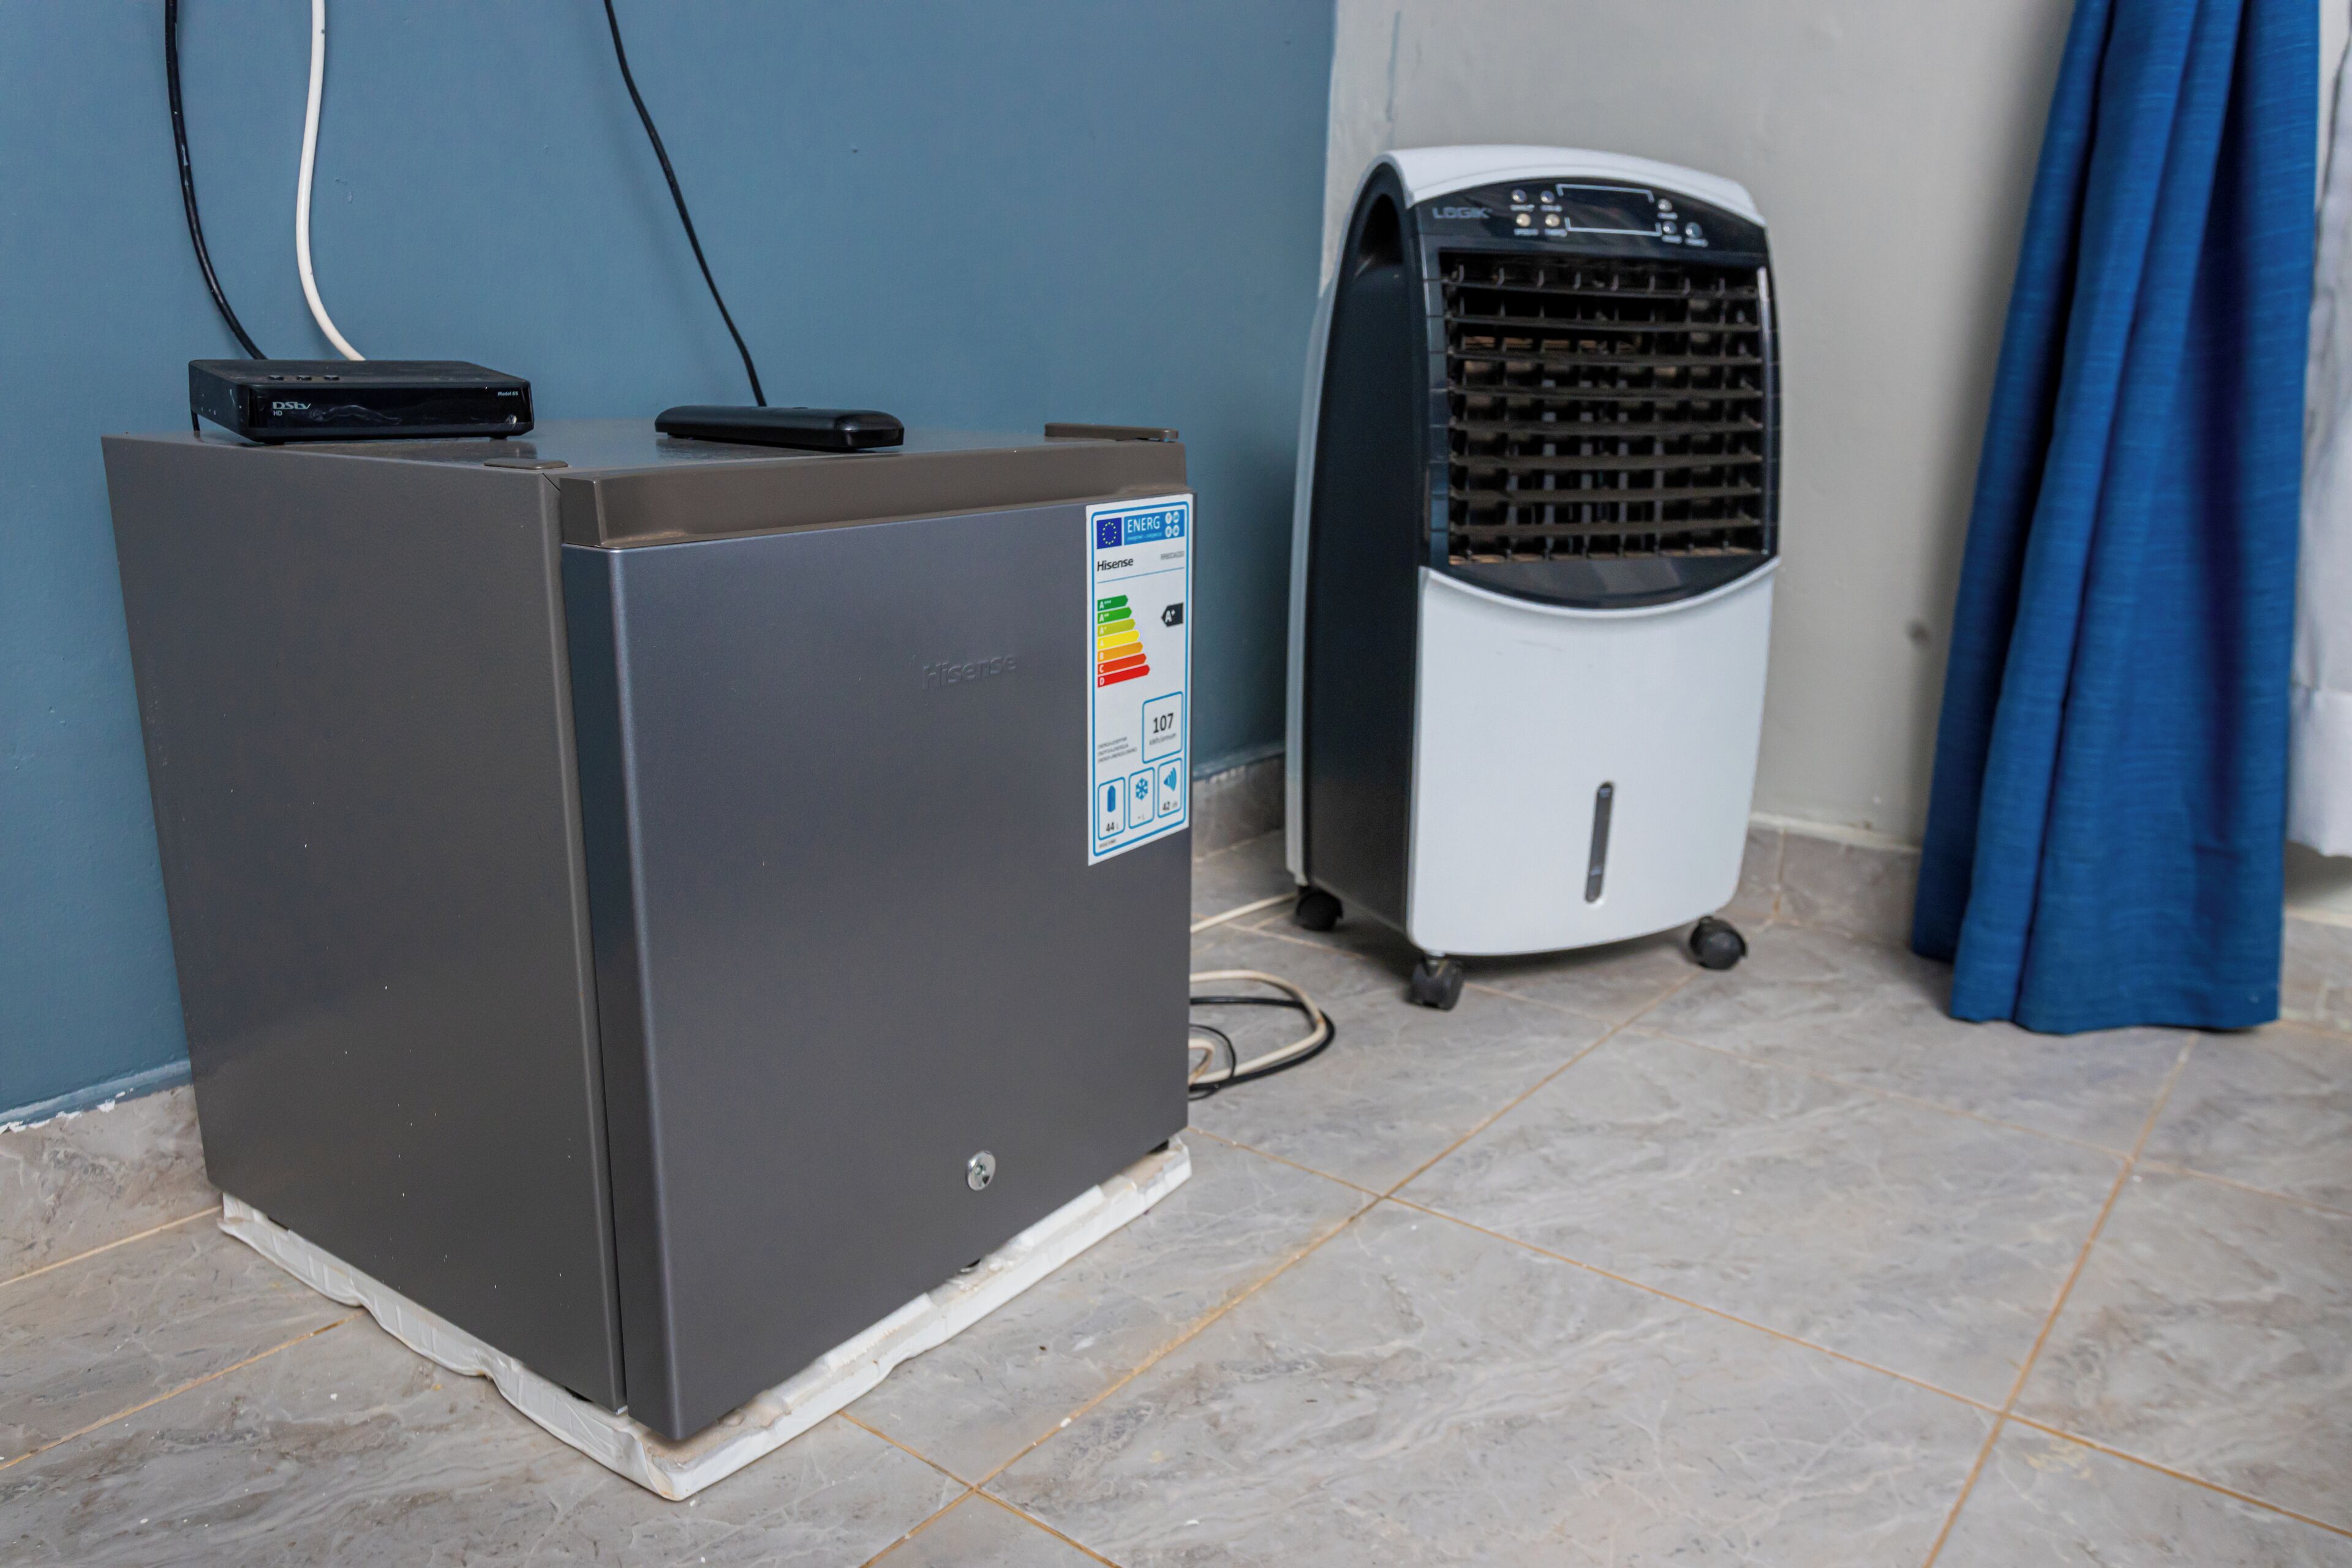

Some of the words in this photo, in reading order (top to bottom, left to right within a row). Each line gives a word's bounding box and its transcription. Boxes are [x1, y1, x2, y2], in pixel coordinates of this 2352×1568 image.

[1128, 516, 1160, 533] ENERG
[1097, 558, 1134, 572] Hisense
[1165, 609, 1175, 623] A+
[922, 654, 1017, 690] Hisense
[1099, 677, 1105, 686] D
[1153, 712, 1174, 734] 107
[1163, 801, 1170, 812] 42
[1106, 821, 1115, 833] 44
